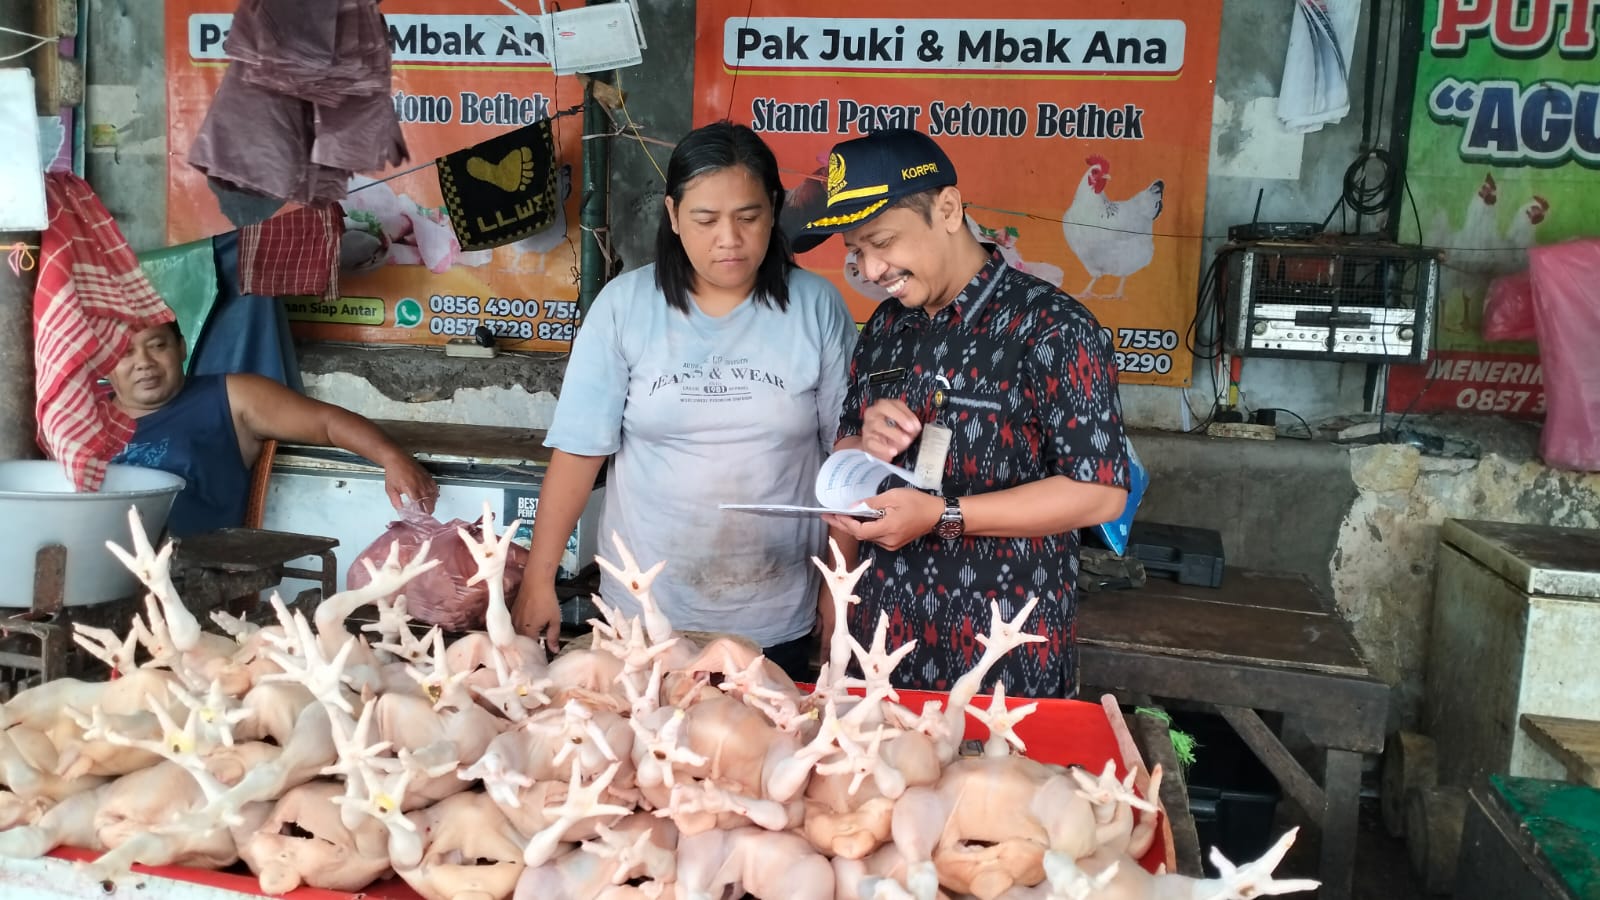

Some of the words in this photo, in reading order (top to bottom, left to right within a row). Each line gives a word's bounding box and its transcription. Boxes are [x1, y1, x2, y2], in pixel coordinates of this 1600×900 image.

[388, 24, 486, 55] Mbak
[737, 28, 809, 61] Pak
[820, 26, 905, 62] Juki
[917, 30, 944, 62] &
[958, 29, 1071, 64] Mbak
[1083, 31, 1167, 64] Ana
[460, 92, 550, 126] Bethek
[753, 98, 829, 133] Stand
[837, 99, 922, 134] Pasar
[928, 101, 1028, 138] Setono
[1036, 102, 1145, 140] Bethek
[901, 162, 939, 180] KORPRI
[311, 303, 338, 317] Siap
[341, 304, 377, 316] Antar
[429, 295, 480, 315] 0856
[484, 298, 539, 318] 4900
[429, 316, 480, 336] 0857
[484, 319, 533, 339] 3228
[1118, 328, 1179, 351] 7550
[1115, 351, 1173, 375] 8290
[709, 367, 722, 380] &
[730, 367, 786, 391] WEAR
[1456, 388, 1530, 412] 0857
